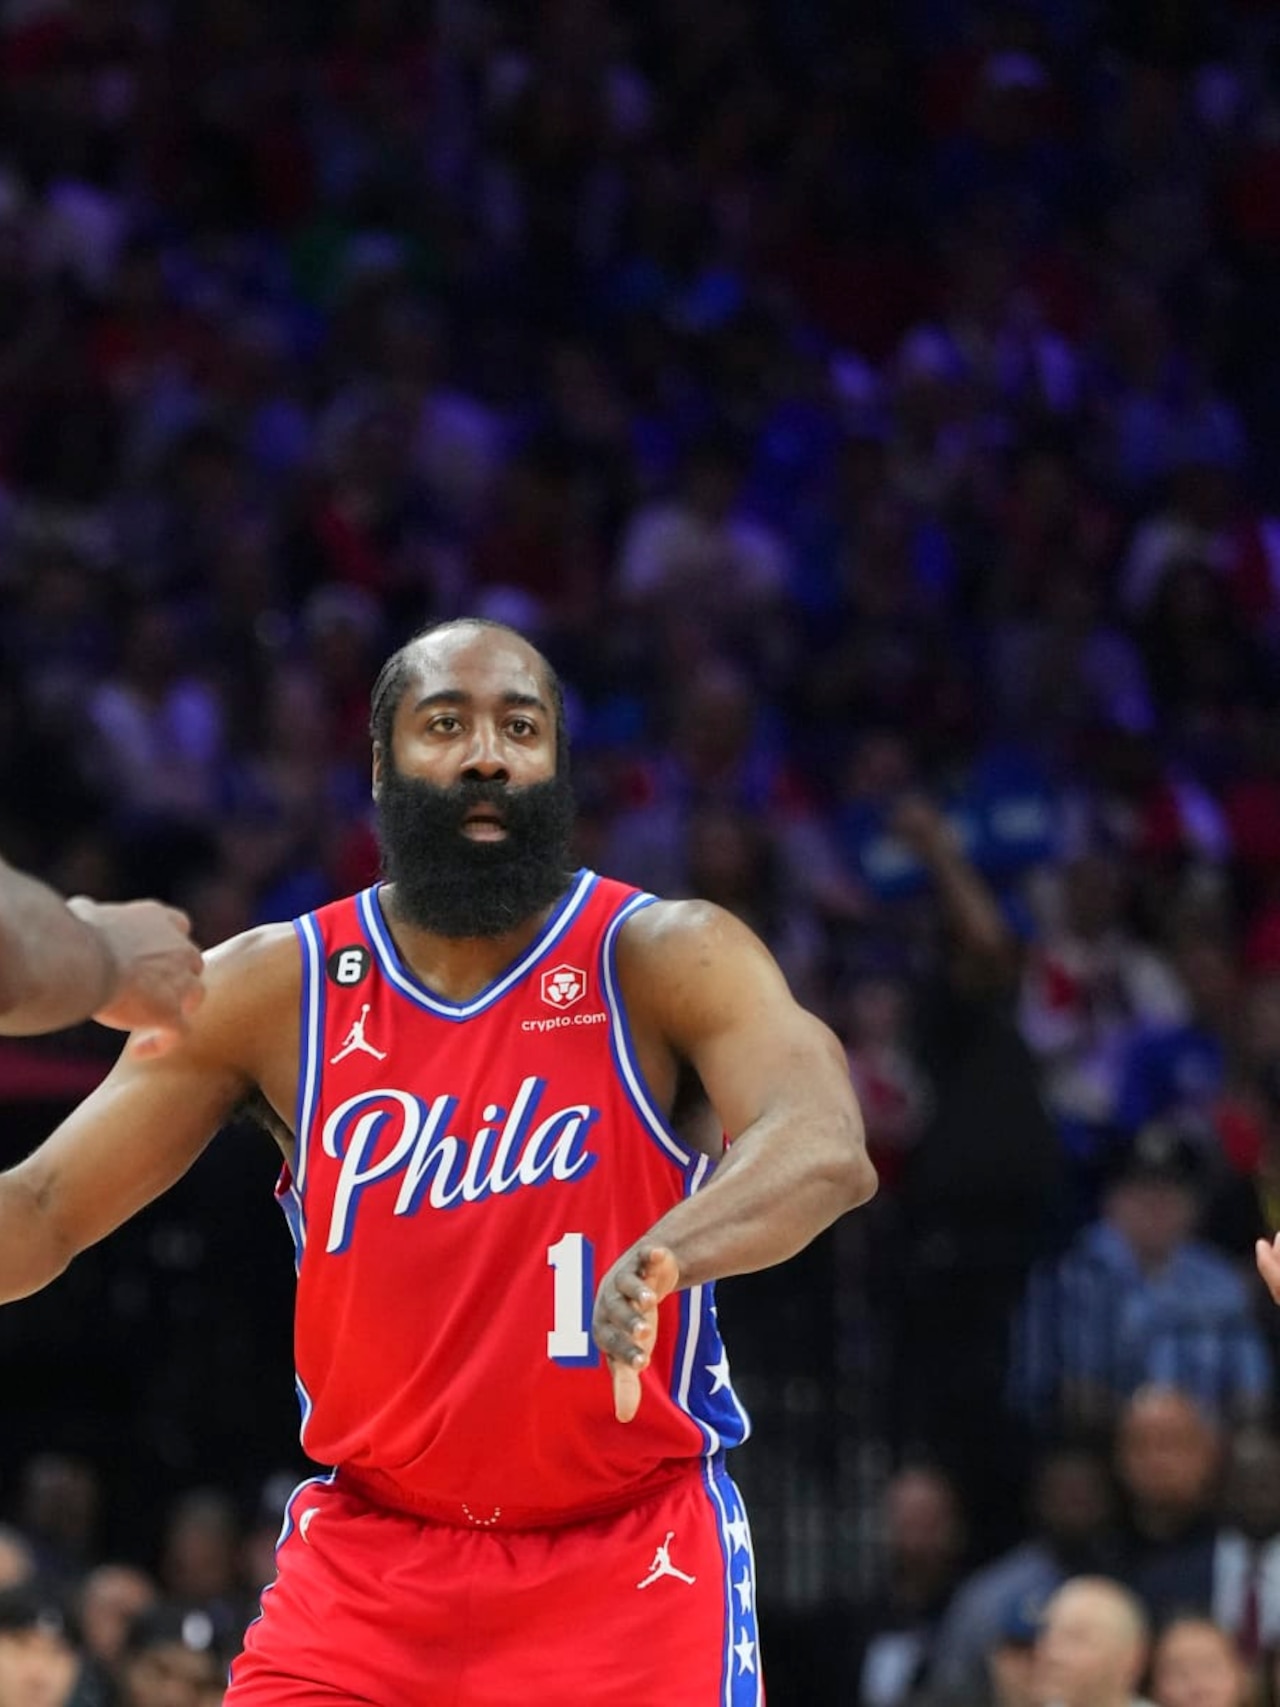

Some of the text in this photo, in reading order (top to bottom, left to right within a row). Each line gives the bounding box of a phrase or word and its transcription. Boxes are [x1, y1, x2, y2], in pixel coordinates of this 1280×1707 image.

[336, 949, 363, 984] 6
[521, 1010, 607, 1033] crypto.com
[322, 1075, 602, 1255] Phila
[547, 1232, 600, 1368] 1
